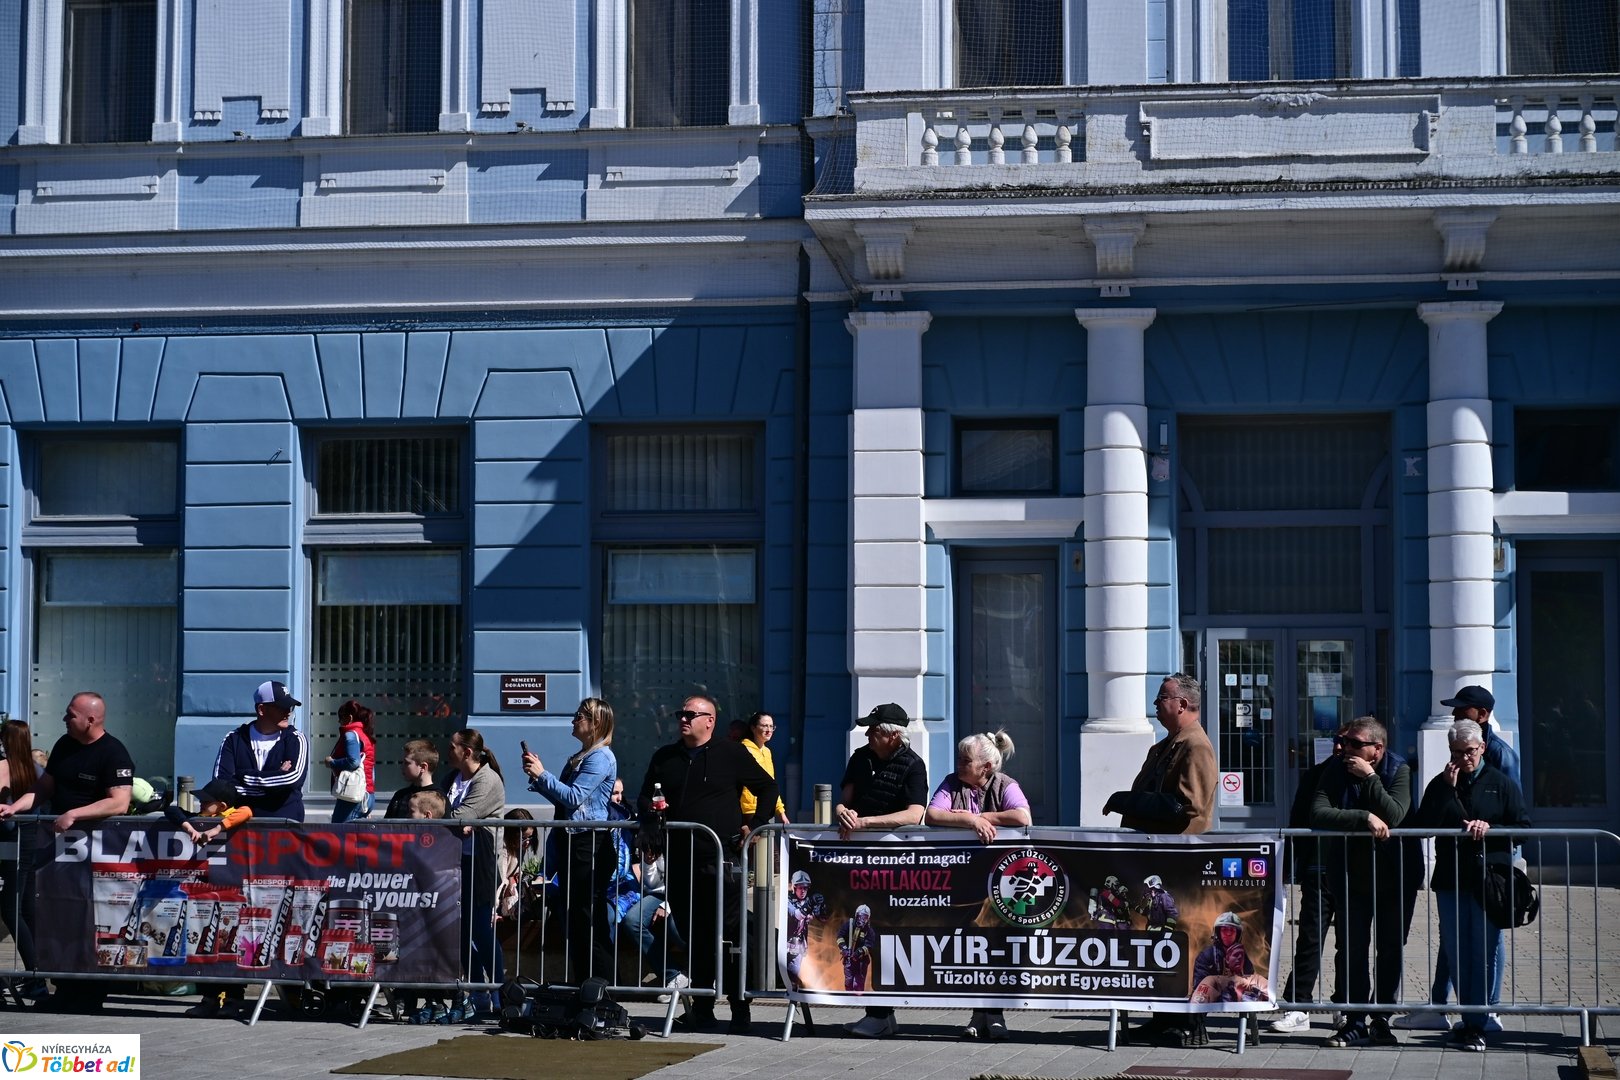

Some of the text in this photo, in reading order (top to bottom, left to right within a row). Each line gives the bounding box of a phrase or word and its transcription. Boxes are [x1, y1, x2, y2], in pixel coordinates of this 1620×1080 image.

[809, 850, 972, 867] Próbára tennéd magad?
[327, 872, 413, 892] the power
[850, 869, 952, 890] CSATLAKOZZ
[363, 891, 439, 911] is yours!
[889, 894, 951, 907] hozzánk!
[203, 902, 219, 953] WHEY
[270, 888, 294, 959] PROTEIN
[304, 901, 327, 957] BCAA
[1017, 916, 1040, 925] Sport
[880, 928, 1181, 986] NYÍR-TŰZOLTÓ
[934, 970, 1155, 990] Tűzoltó és Sport Egyesület
